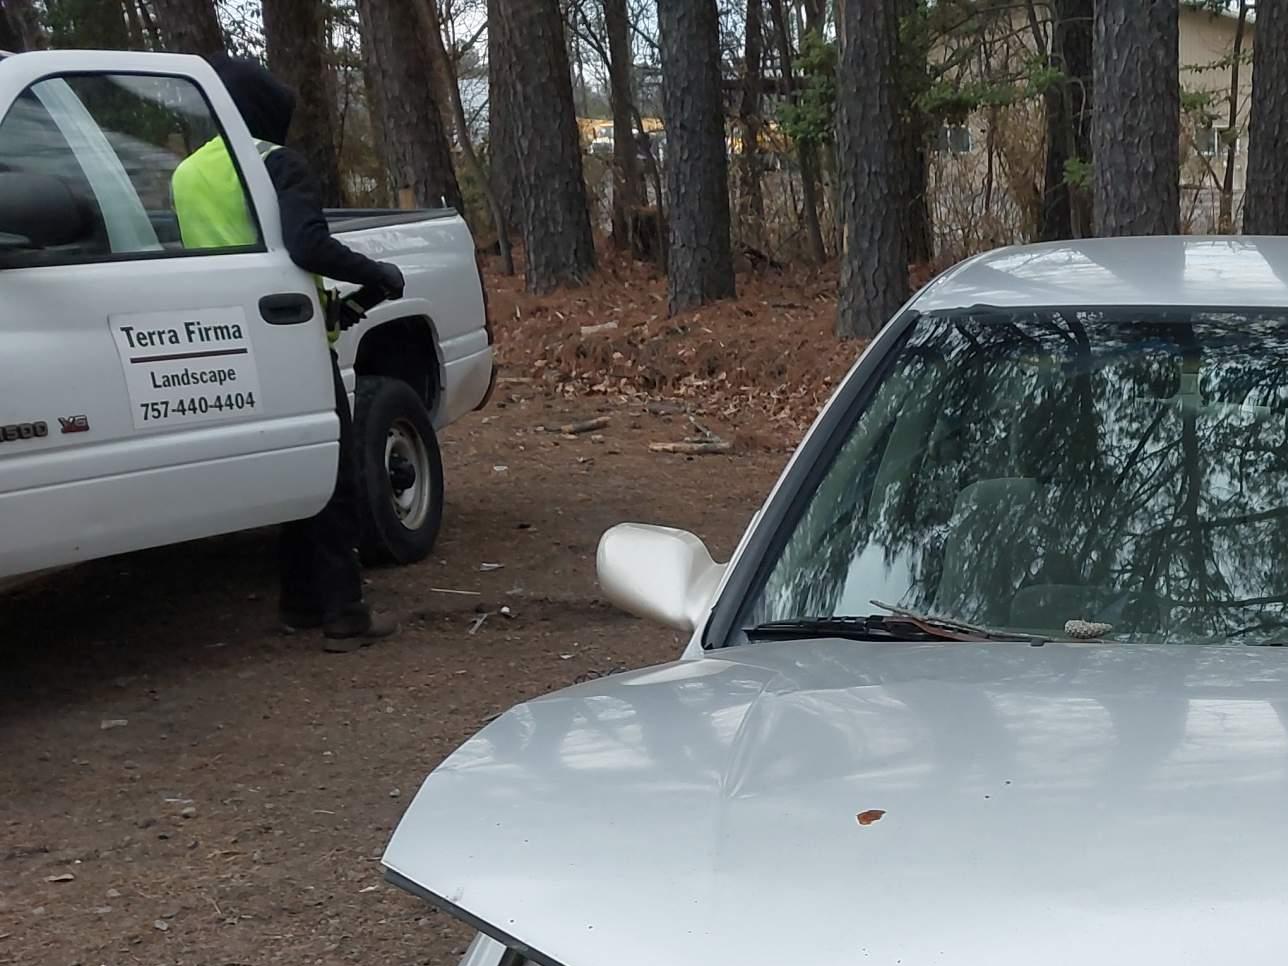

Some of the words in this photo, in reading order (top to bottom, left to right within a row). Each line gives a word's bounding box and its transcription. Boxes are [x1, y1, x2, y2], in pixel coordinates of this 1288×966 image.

[120, 326, 180, 348] Terra
[184, 321, 243, 343] Firma
[150, 368, 237, 389] Landscape
[140, 391, 256, 421] 757-440-4404
